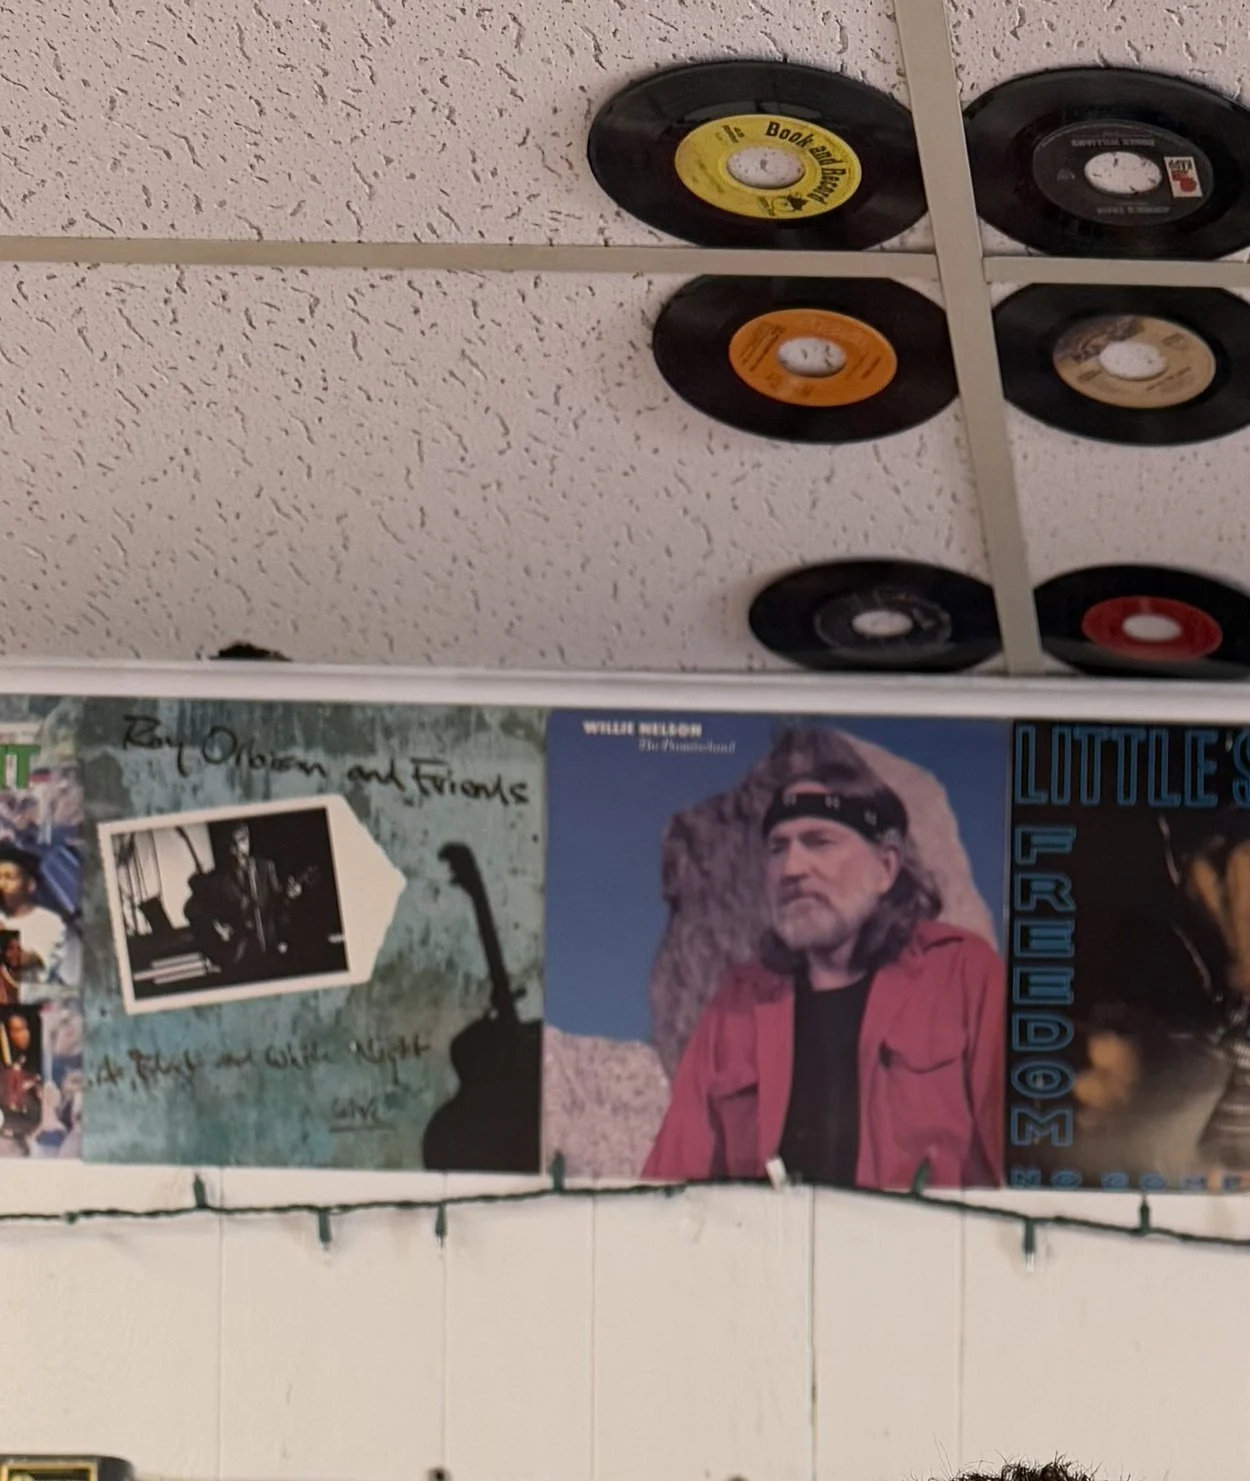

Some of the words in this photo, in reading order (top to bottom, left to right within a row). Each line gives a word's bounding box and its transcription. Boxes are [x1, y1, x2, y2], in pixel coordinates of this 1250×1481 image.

[765, 121, 813, 148] Book
[809, 145, 843, 166] and
[806, 166, 847, 206] Record
[582, 720, 634, 736] WILLIE
[638, 722, 702, 738] NELSON
[346, 764, 405, 798] and
[411, 755, 531, 806] Friends
[1013, 723, 1219, 808] LITTLE
[1010, 825, 1077, 1148] FREEDOM
